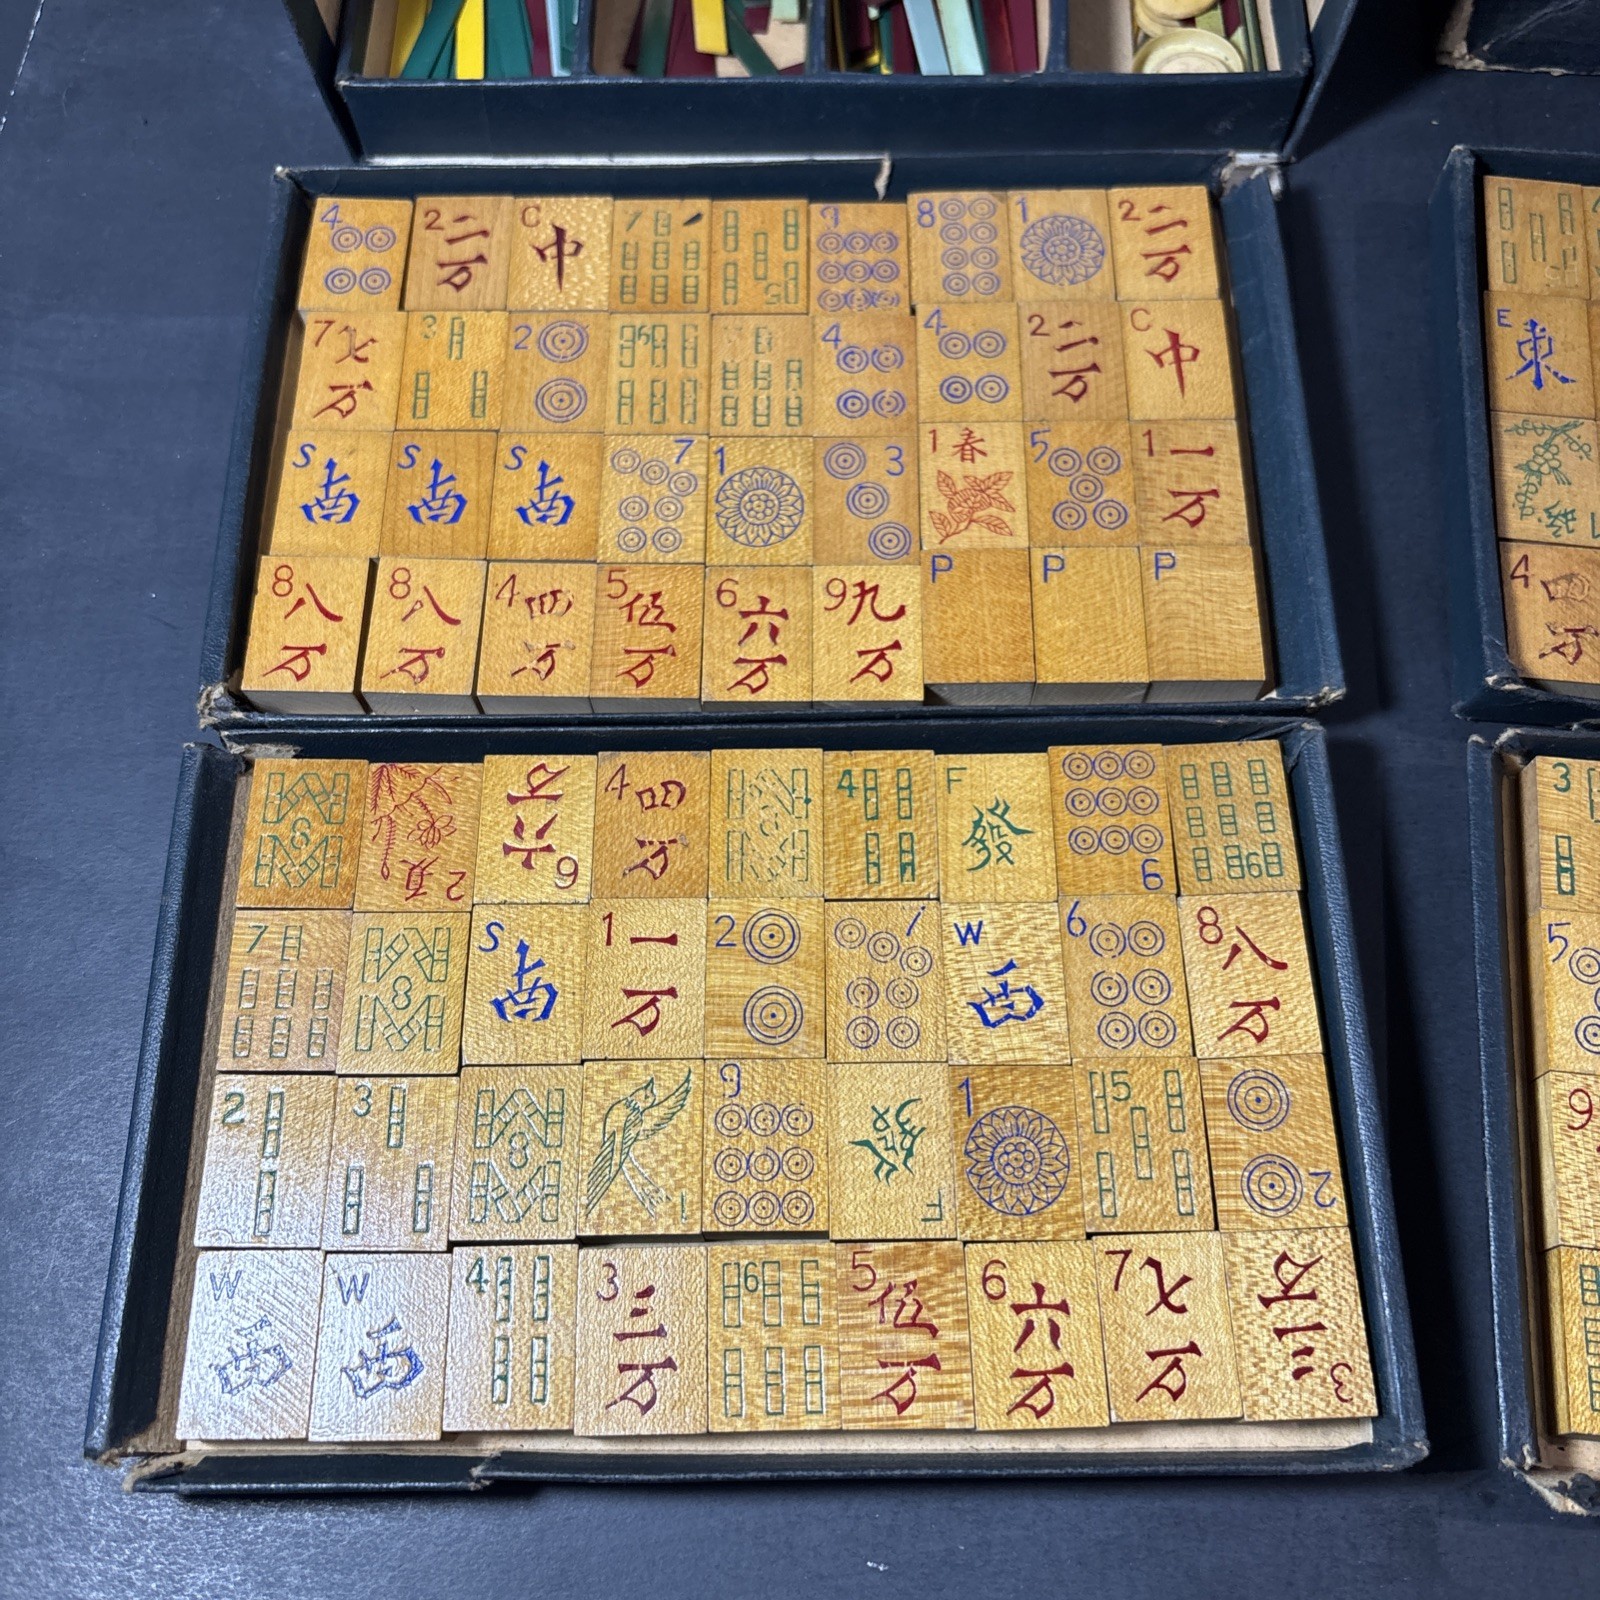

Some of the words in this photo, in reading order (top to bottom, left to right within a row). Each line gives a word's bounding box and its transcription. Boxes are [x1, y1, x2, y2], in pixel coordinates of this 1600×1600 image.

[321, 204, 342, 229] 4
[424, 210, 444, 231] 2
[521, 206, 541, 228] C
[917, 199, 936, 228] 8
[1016, 199, 1029, 223] 1
[1118, 201, 1140, 222] 2
[533, 224, 583, 293] 中
[312, 320, 333, 346] 7
[422, 315, 438, 340] 3
[924, 308, 947, 335] 4
[1028, 315, 1051, 337] 2
[1130, 308, 1152, 332] C
[1497, 309, 1512, 328] E
[513, 325, 532, 351] 2
[821, 323, 842, 349] 4
[1145, 328, 1200, 398] 中
[1505, 319, 1576, 391] 東
[293, 443, 317, 468] S
[398, 444, 421, 470] S
[674, 439, 694, 464] 7
[928, 429, 938, 453] 1
[951, 427, 988, 465] 春
[1030, 429, 1049, 463] 5
[1142, 429, 1155, 456] 1
[505, 445, 529, 471] S
[714, 446, 725, 475] 1
[884, 446, 904, 476] 3
[299, 458, 361, 525] 南
[406, 458, 468, 525] 南
[515, 460, 576, 526] 南
[272, 565, 294, 597] 8
[931, 555, 954, 583] P
[1043, 555, 1066, 583] P
[1154, 553, 1177, 581] P
[1510, 554, 1529, 589] 4
[389, 567, 411, 600] 8
[495, 573, 518, 607] 4
[607, 569, 628, 599] 5
[716, 578, 739, 608] 6
[824, 577, 847, 611] 9
[604, 764, 627, 799] 4
[837, 769, 859, 798] 4
[947, 767, 966, 794] F
[1553, 762, 1571, 792] 3
[962, 798, 1034, 872] 發
[446, 871, 467, 900] 2
[603, 912, 615, 946] 1
[714, 915, 737, 947] 2
[954, 921, 983, 945] W
[1067, 901, 1087, 936] 6
[1197, 906, 1223, 944] 8
[247, 925, 267, 954] 7
[478, 921, 504, 952] S
[1548, 922, 1571, 962] 5
[392, 975, 412, 1010] 8
[490, 940, 558, 1023] 南
[968, 960, 1045, 1029] 西
[720, 1063, 741, 1098] 9
[1113, 1076, 1132, 1102] 5
[223, 1092, 246, 1124] 2
[352, 1084, 372, 1116] 3
[958, 1077, 973, 1117] 1
[1567, 1088, 1593, 1130] 9
[509, 1131, 530, 1169] 8
[921, 1189, 943, 1222] F
[1308, 1171, 1337, 1209] 2
[210, 1270, 244, 1301] W
[465, 1258, 489, 1293] 4
[597, 1263, 619, 1300] 3
[742, 1261, 759, 1293] 6
[852, 1250, 877, 1290] 5
[981, 1259, 1007, 1300] 6
[1104, 1250, 1134, 1291] 7
[337, 1272, 370, 1305] W
[1329, 1362, 1354, 1403] 3
